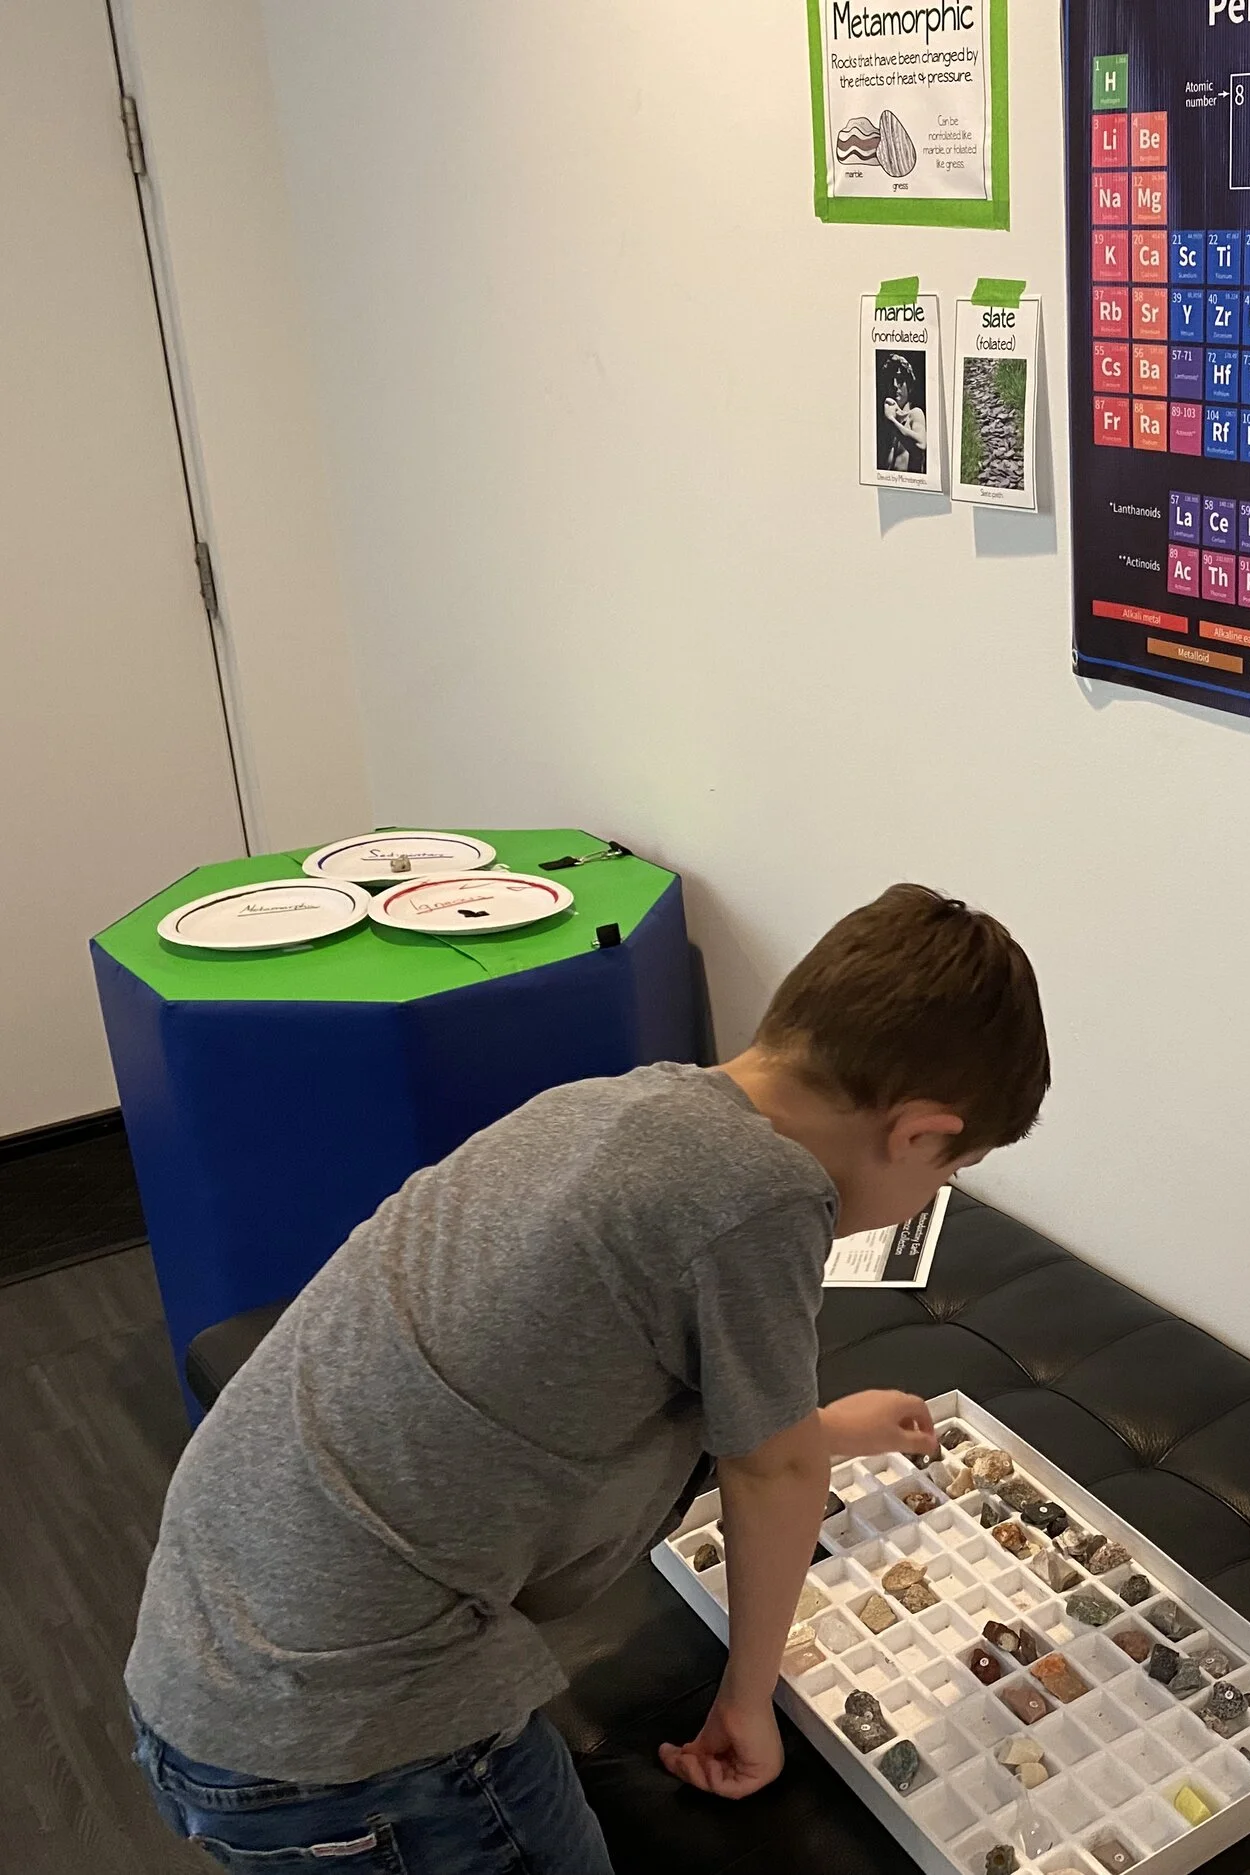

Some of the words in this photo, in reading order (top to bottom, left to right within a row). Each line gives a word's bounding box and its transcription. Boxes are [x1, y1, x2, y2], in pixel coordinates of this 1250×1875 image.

[833, 0, 974, 45] Metamorphic
[831, 53, 857, 69] Rocks
[858, 54, 873, 67] that
[874, 53, 896, 66] have
[898, 50, 920, 64] been
[922, 47, 965, 67] changed
[966, 47, 978, 66] by
[840, 74, 854, 88] the
[855, 73, 884, 87] effects
[886, 72, 896, 86] of
[897, 71, 917, 85] heat
[918, 73, 926, 84] &
[928, 71, 973, 88] pressure.
[1105, 71, 1117, 92] H
[1185, 80, 1214, 92] Atomic
[1186, 96, 1217, 108] number
[1234, 84, 1244, 106] 8
[845, 170, 864, 178] marble
[1104, 245, 1117, 266] K
[874, 302, 925, 322] marble
[982, 306, 1016, 328] slate
[871, 327, 928, 344] (nonfoliated)
[976, 334, 1016, 352] (foliated)
[1171, 350, 1193, 362] 57-71
[1171, 406, 1197, 419] 89-103
[1176, 507, 1192, 527] La
[1122, 609, 1142, 623] Alkali
[1142, 613, 1162, 625] metal
[1214, 627, 1242, 642] Alkaline
[1178, 648, 1210, 663] Metalloid
